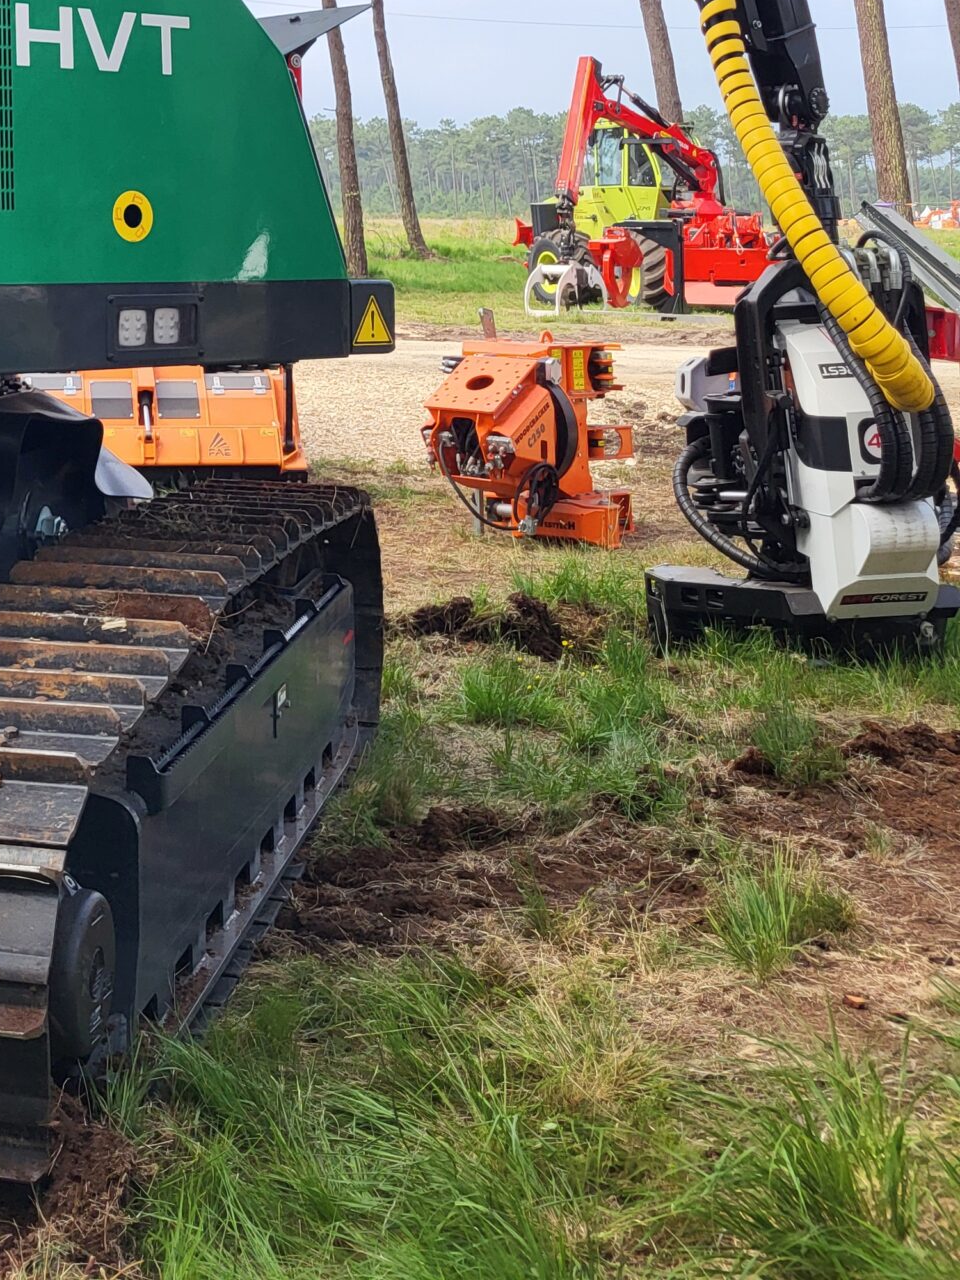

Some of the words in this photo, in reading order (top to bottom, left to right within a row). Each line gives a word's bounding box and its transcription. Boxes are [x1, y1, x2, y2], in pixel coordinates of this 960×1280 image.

[15, 2, 190, 76] HVT
[527, 423, 546, 448] C250
[208, 448, 231, 457] FAE
